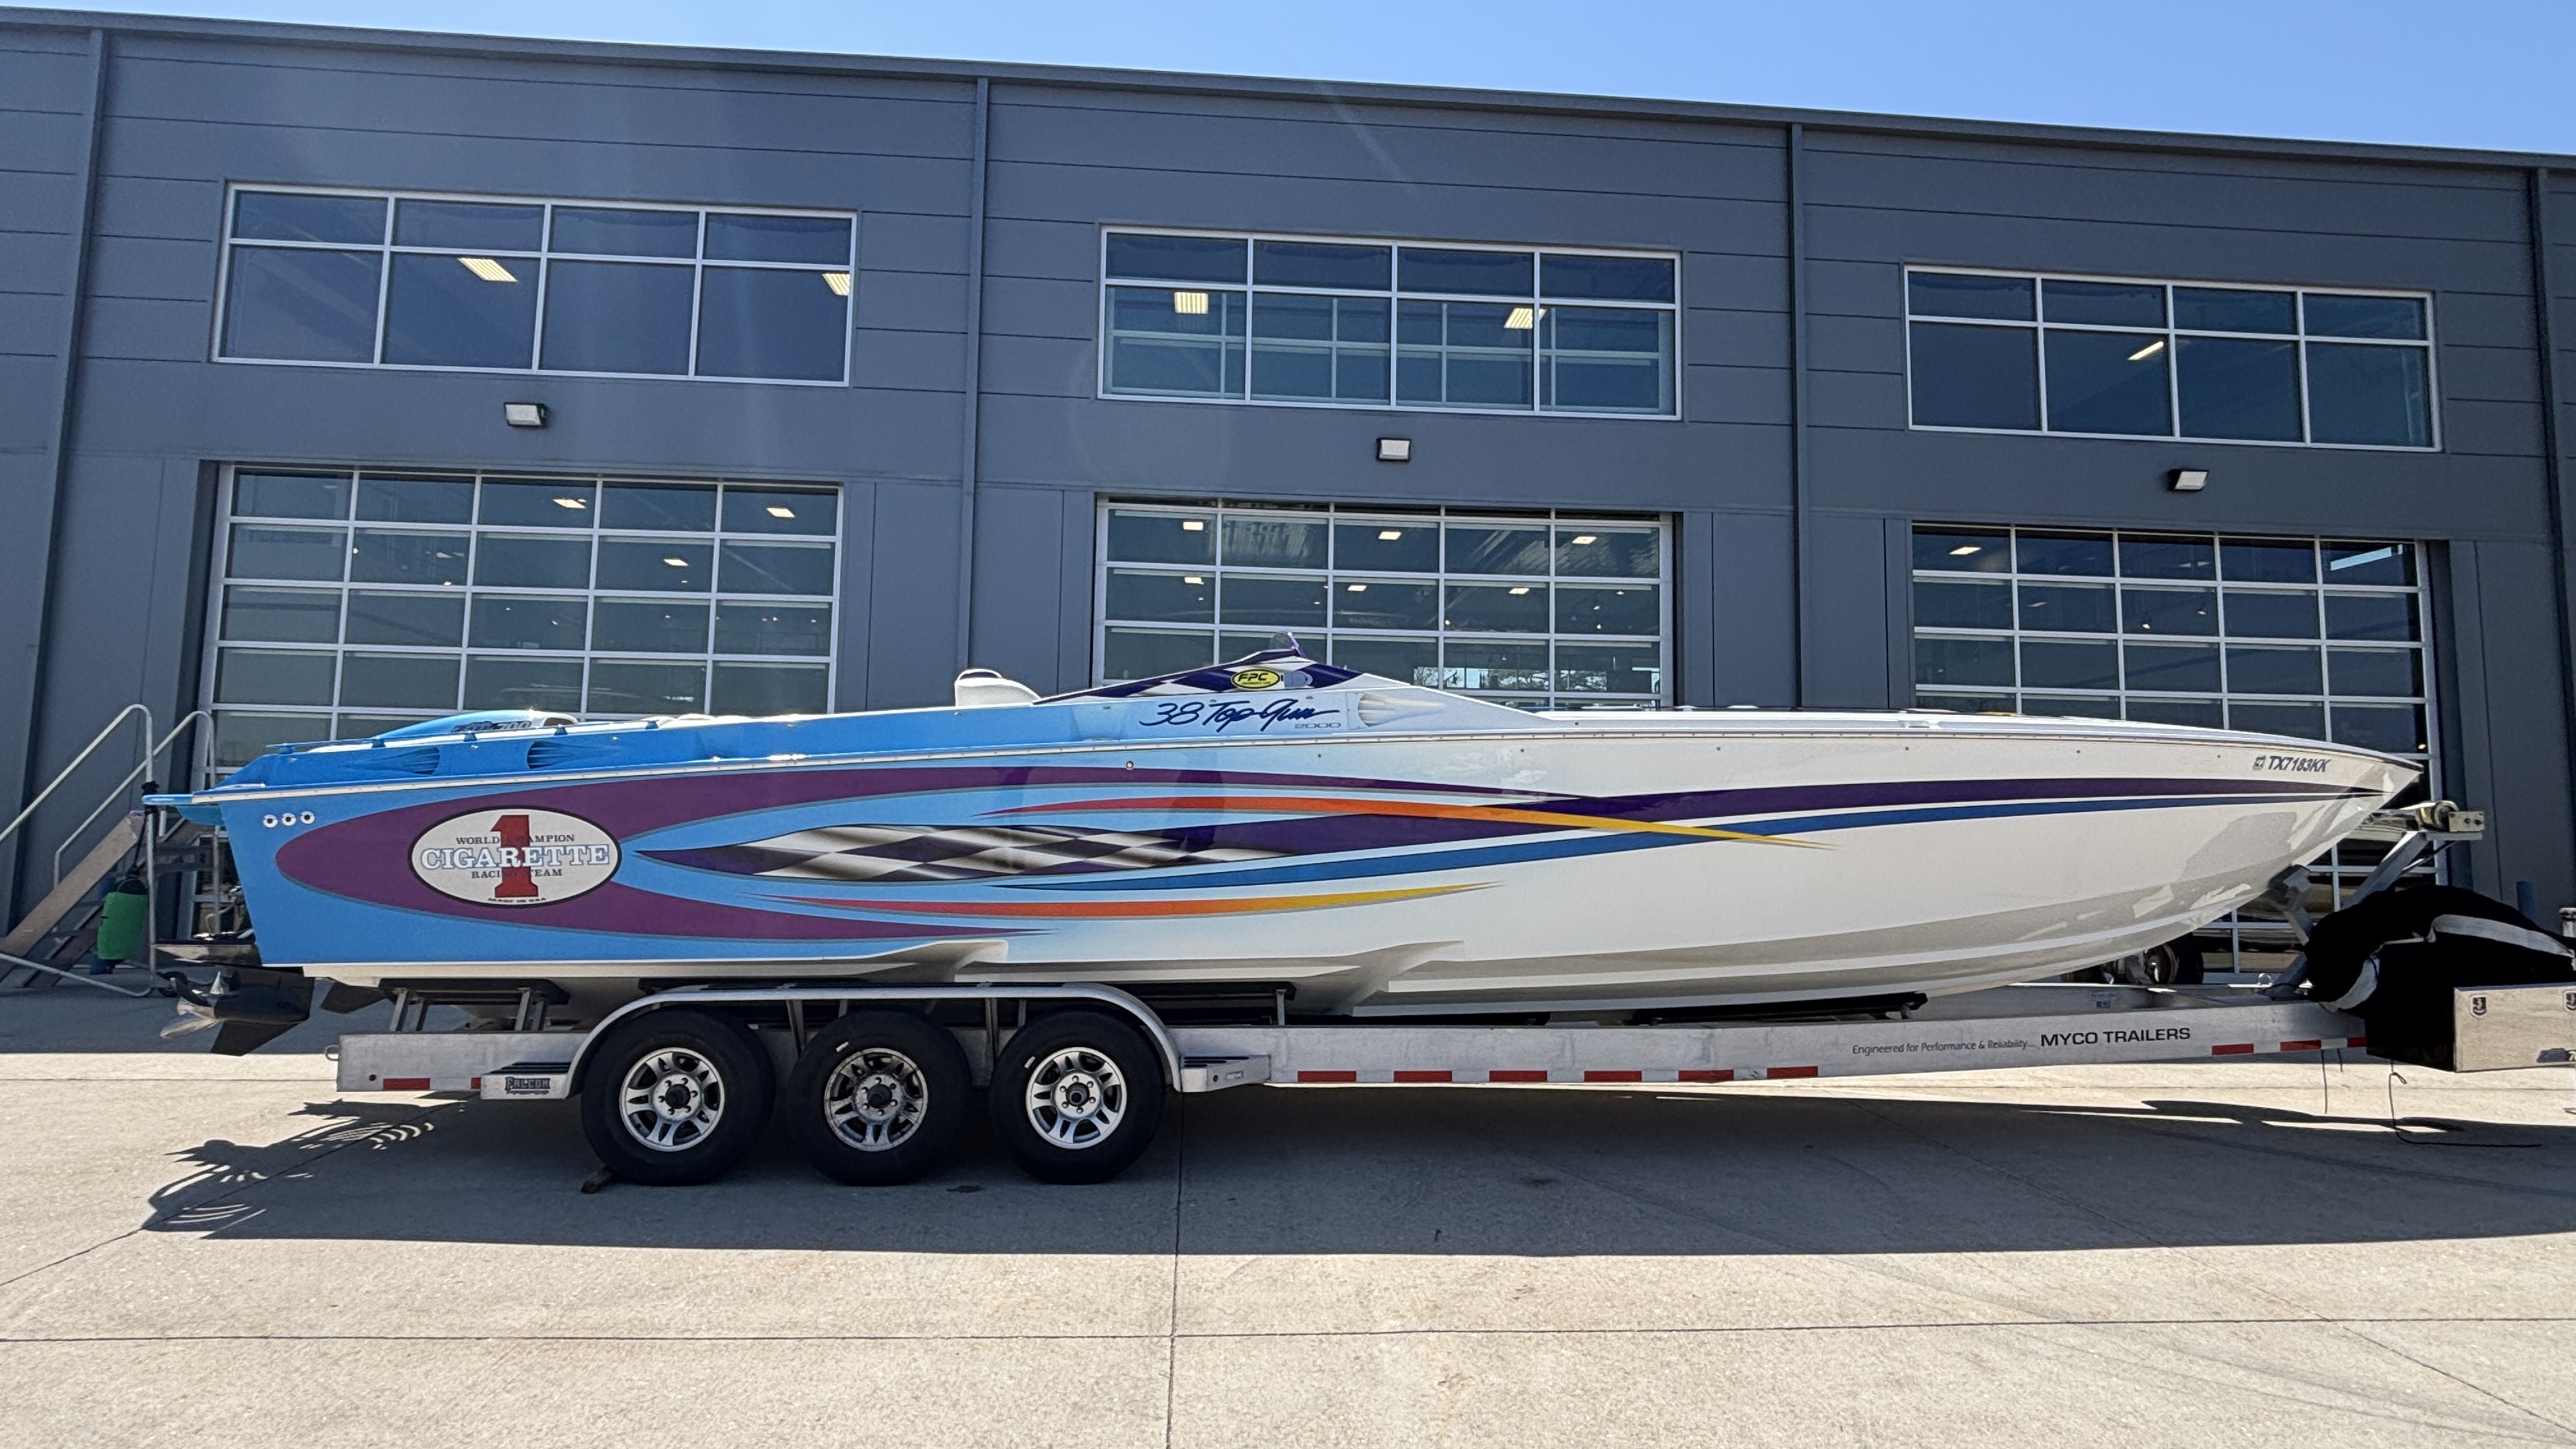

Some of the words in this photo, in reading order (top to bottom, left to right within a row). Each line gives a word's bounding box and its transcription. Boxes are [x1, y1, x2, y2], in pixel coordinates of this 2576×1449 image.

[1237, 673, 1269, 682] FPC
[1139, 702, 1205, 726] 38
[1202, 700, 1259, 733] Top
[2267, 755, 2332, 772] TX7183KK
[456, 836, 500, 845] WORLD
[507, 834, 575, 843] AMPION
[420, 844, 610, 870] CIGARETTE
[490, 815, 539, 898] 1
[471, 870, 517, 879] RACI
[2041, 1031, 2098, 1046] MYCO
[2103, 1027, 2191, 1043] TRAILERS
[1852, 1044, 1905, 1056] Engineered
[1906, 1043, 1919, 1052] for
[1920, 1041, 1977, 1052] Performance
[1978, 1040, 1985, 1049] &
